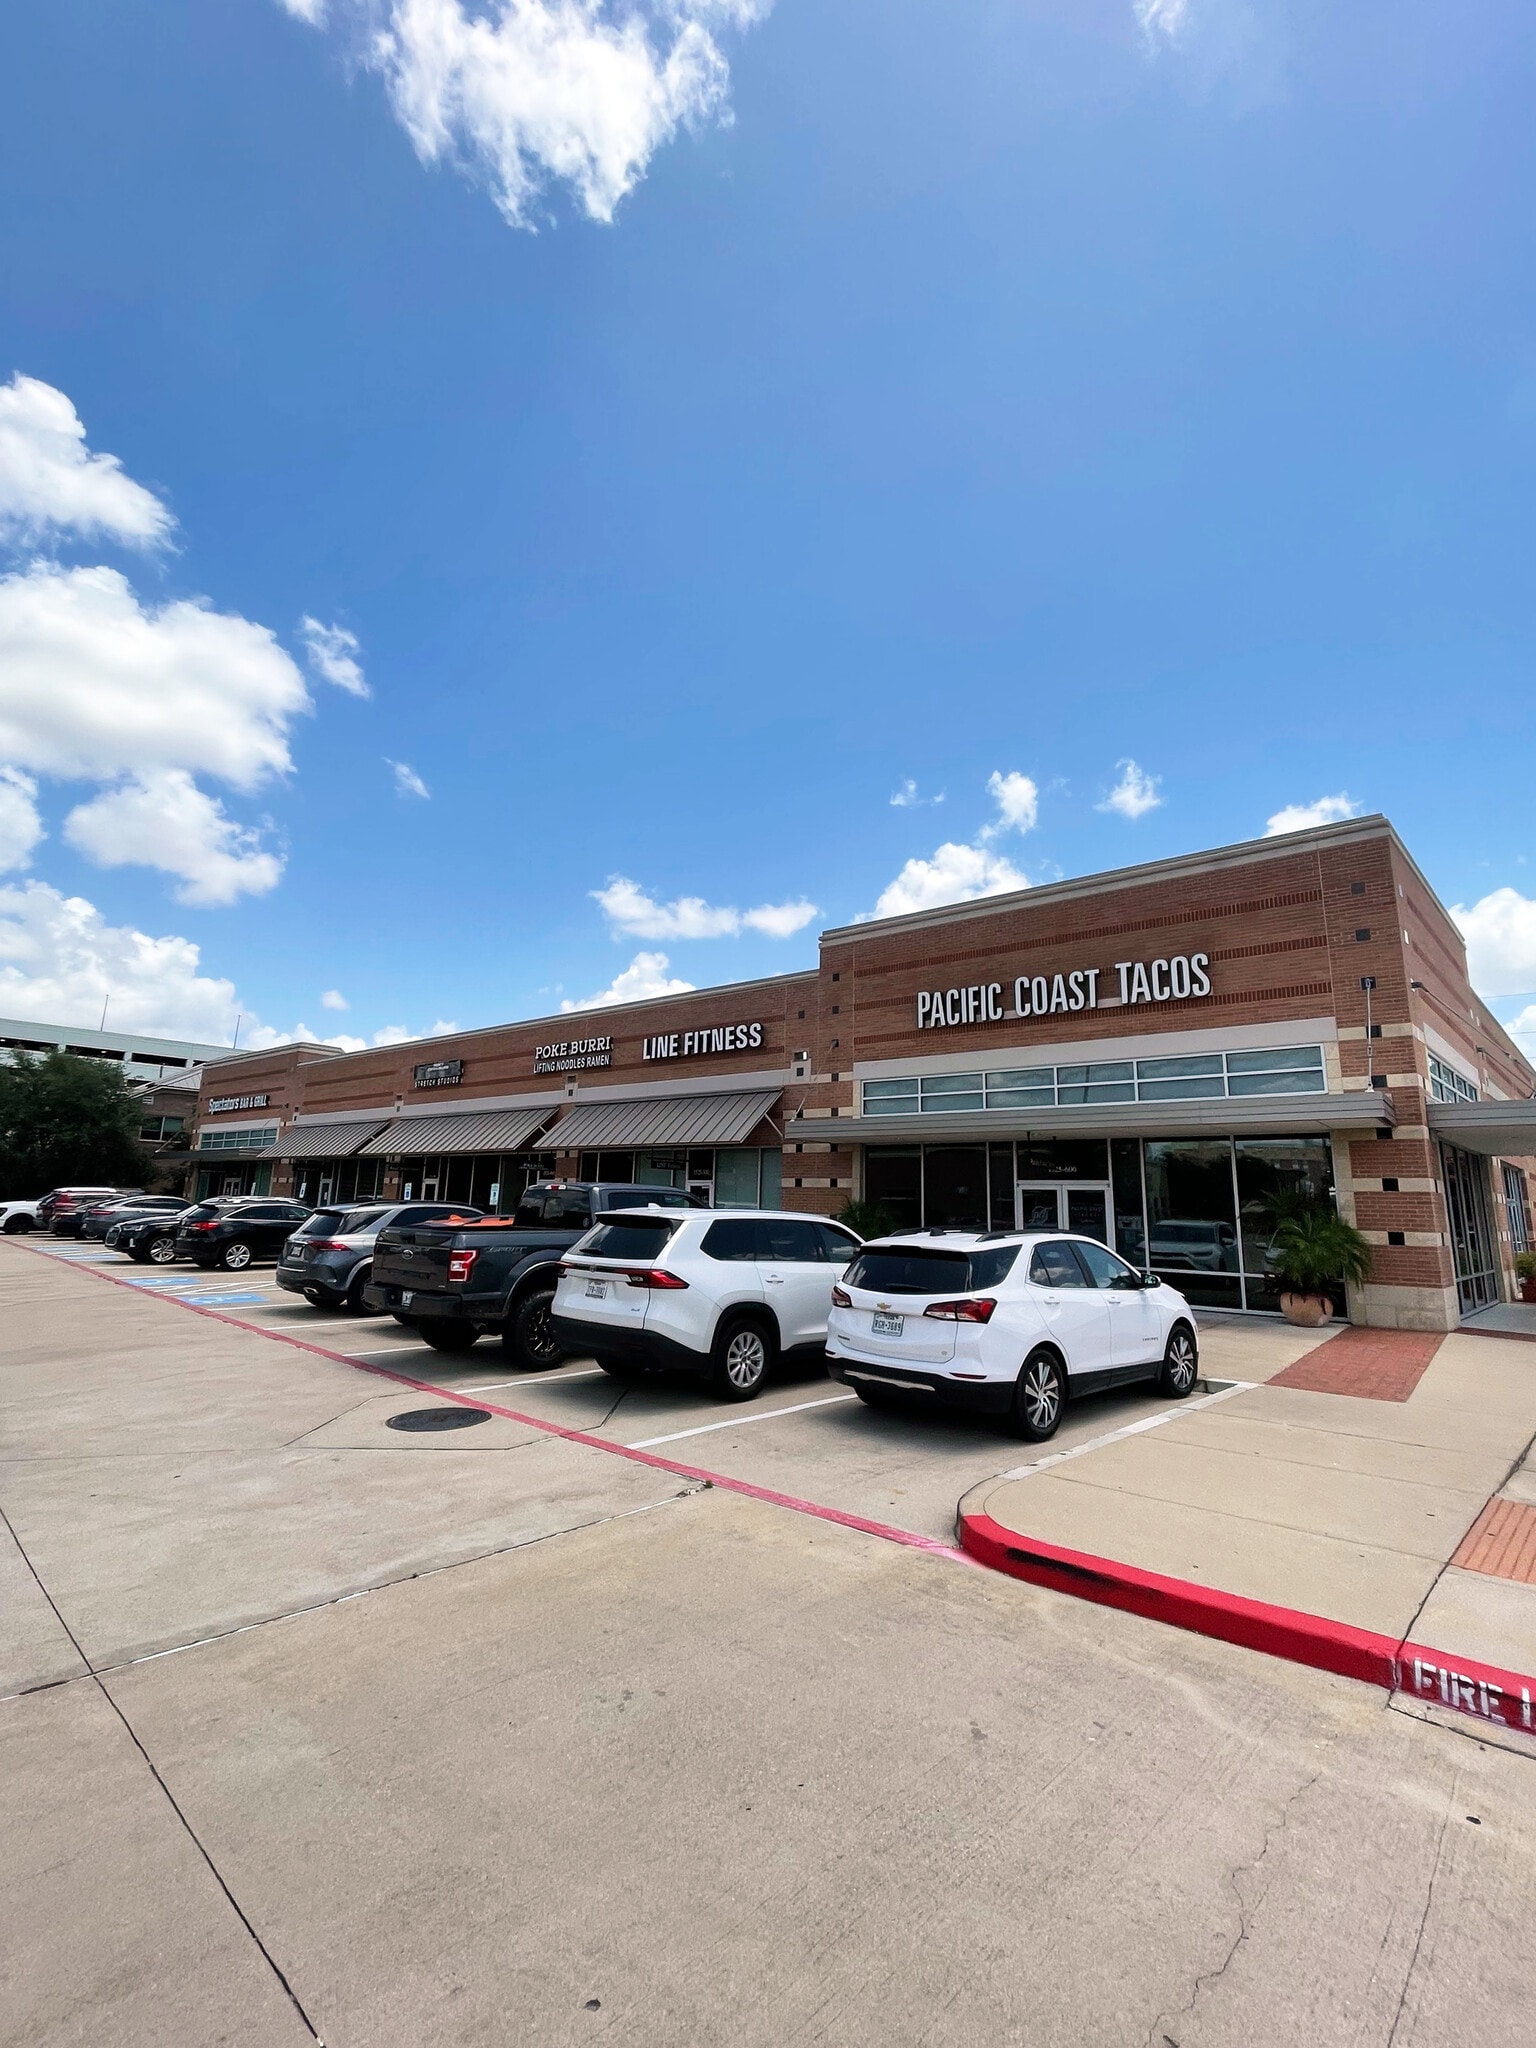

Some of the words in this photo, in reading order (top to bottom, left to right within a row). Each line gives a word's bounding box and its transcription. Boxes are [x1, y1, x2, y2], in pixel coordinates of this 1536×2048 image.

[917, 982, 1002, 1029] PACIFIC
[1014, 968, 1100, 1017] COAST
[1115, 953, 1211, 1005] TACOS
[535, 1043, 568, 1059] POKE
[570, 1036, 611, 1055] BURRI
[643, 1034, 679, 1061] LINE
[683, 1022, 763, 1056] FITNESS
[533, 1061, 555, 1074] LIFTING
[556, 1057, 586, 1072] NOODLES
[586, 1054, 610, 1067] RAMEN
[414, 1079, 436, 1088] STRETCH
[437, 1075, 459, 1086] STUDIOS
[1413, 1657, 1507, 1723] FIRE
